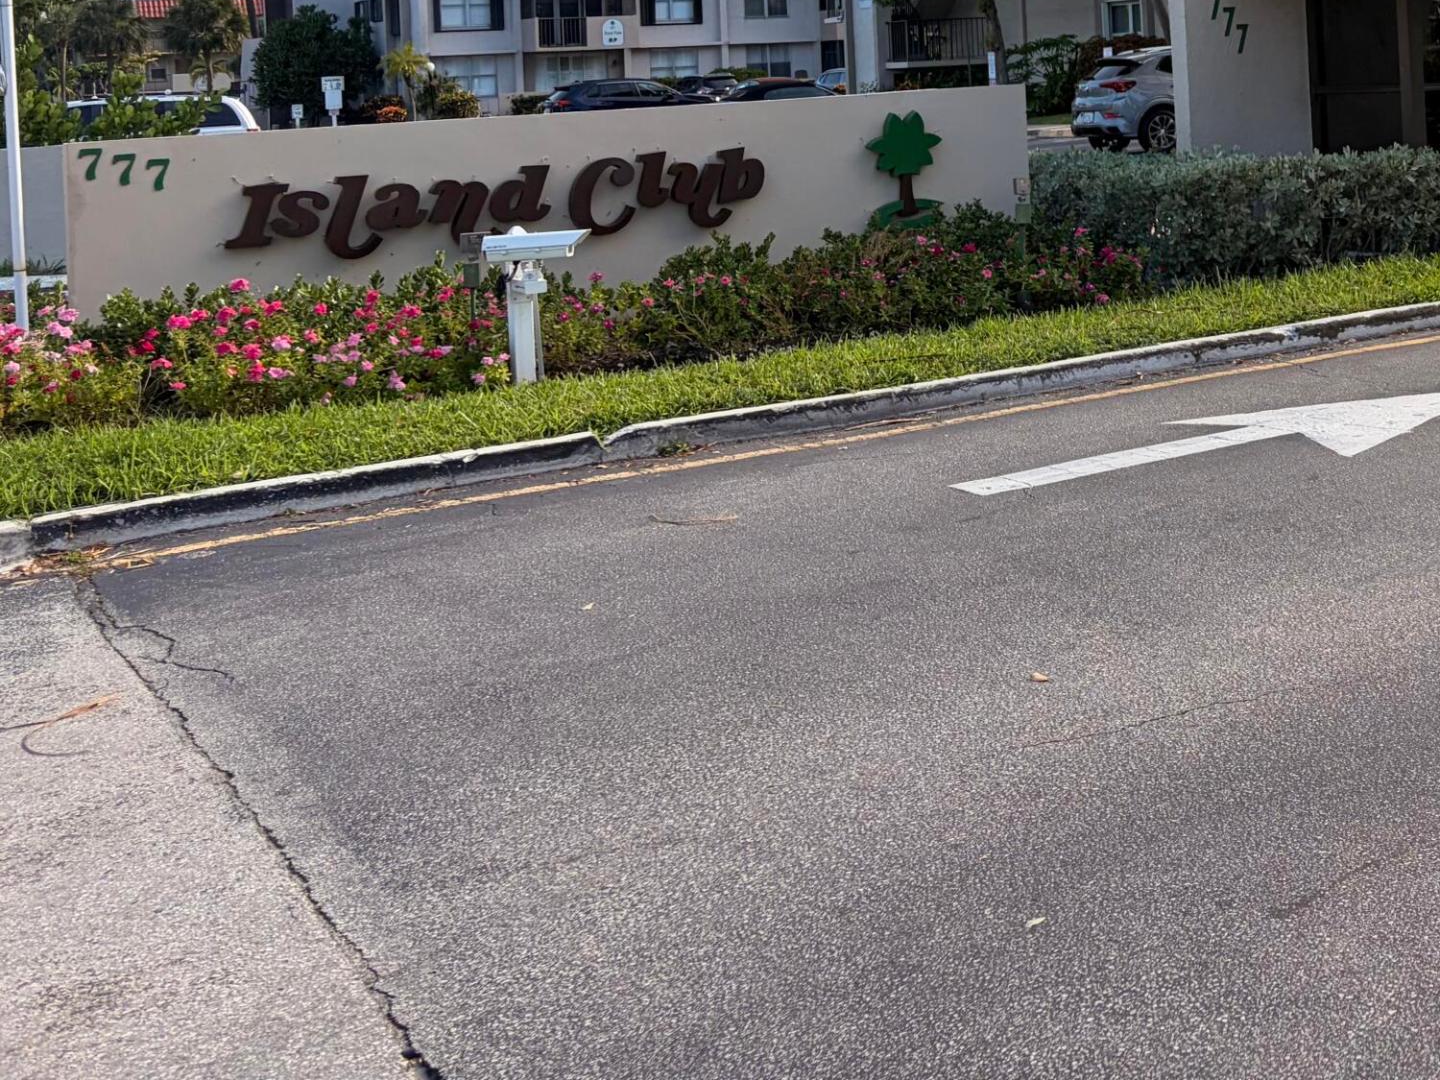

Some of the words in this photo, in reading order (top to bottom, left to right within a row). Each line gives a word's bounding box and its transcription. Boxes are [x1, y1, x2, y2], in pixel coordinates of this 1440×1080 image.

[78, 148, 170, 191] 777
[224, 164, 551, 260] Island
[568, 147, 766, 236] Club
